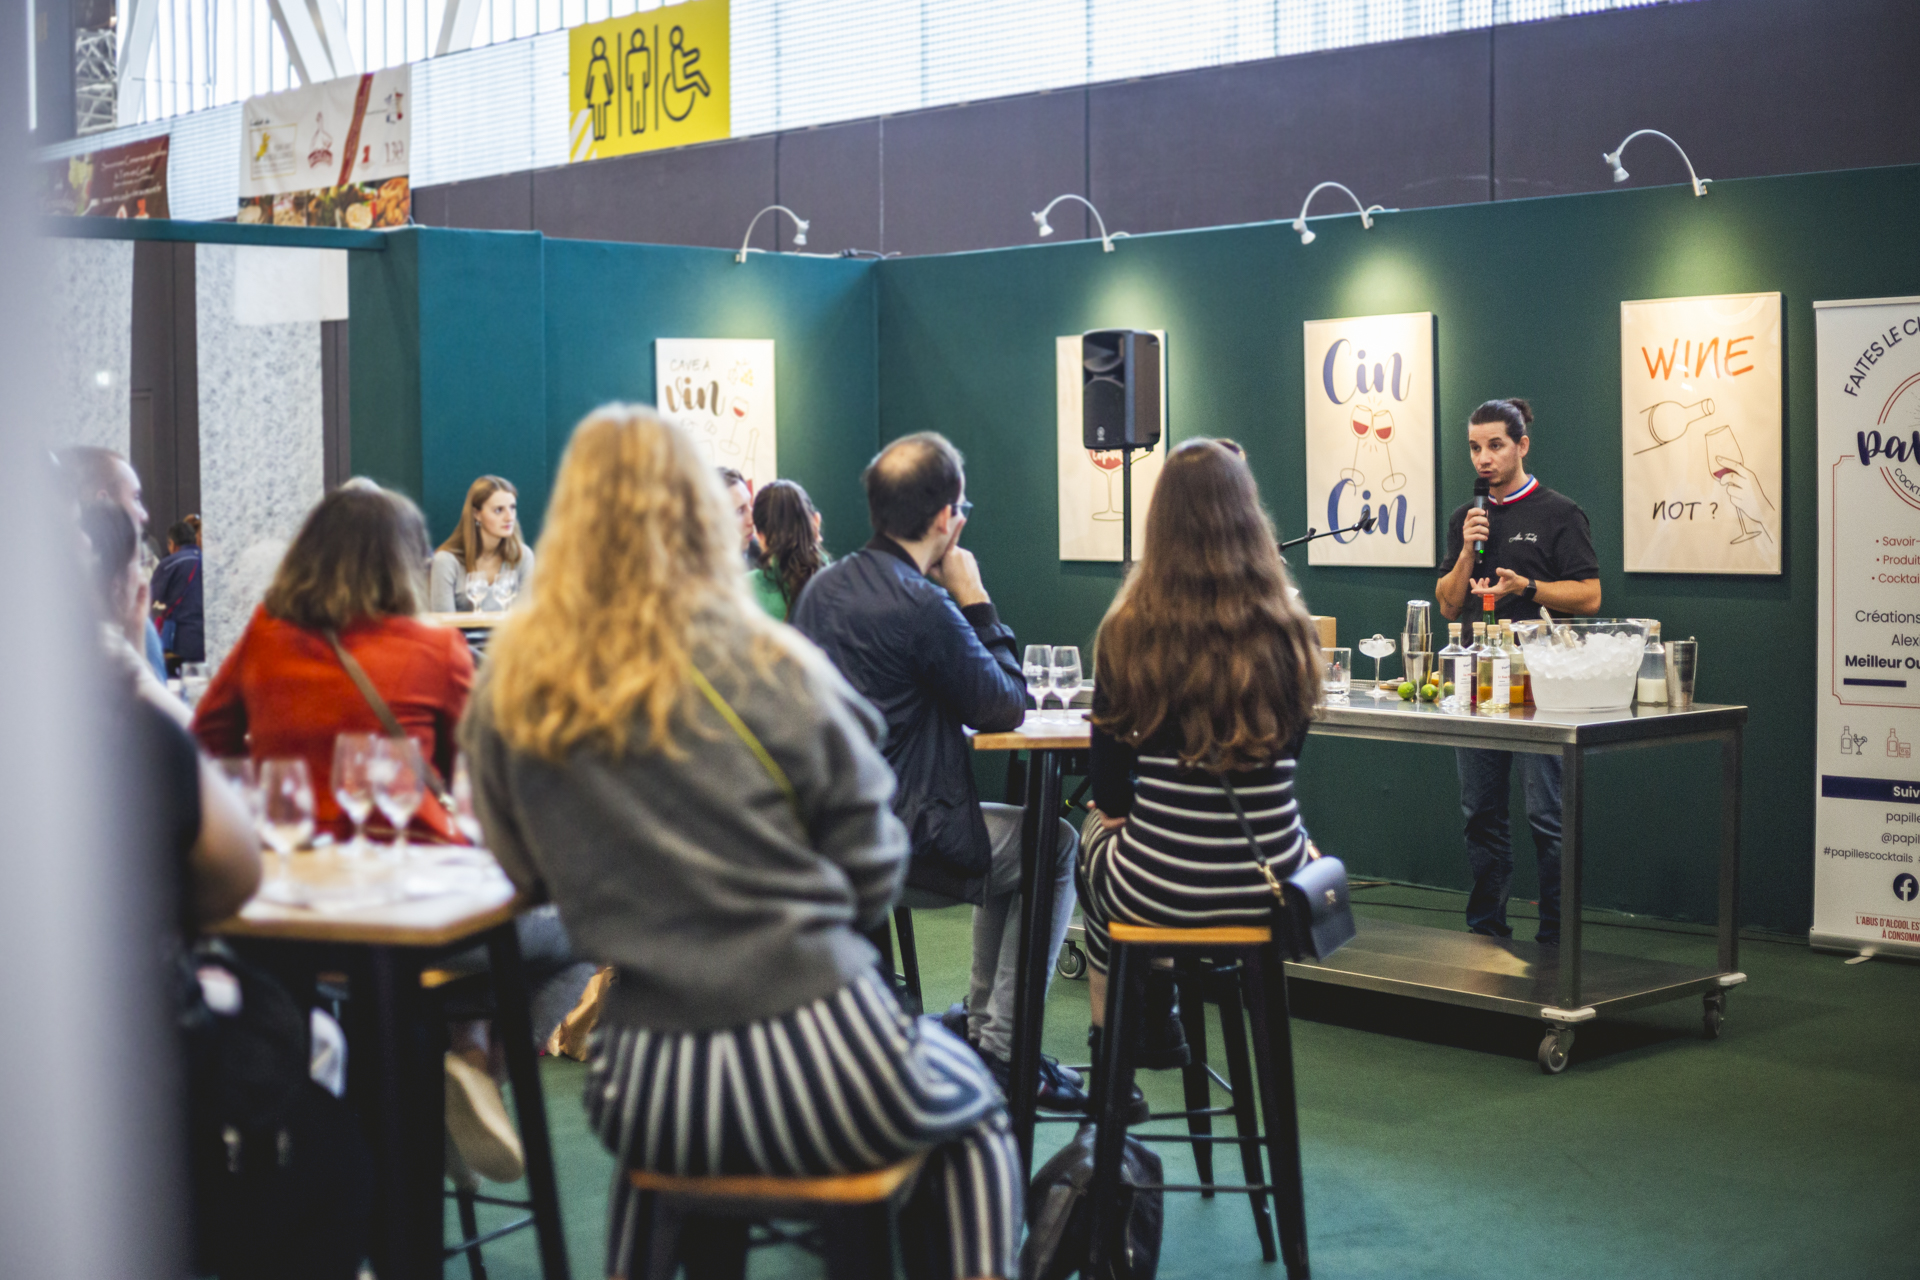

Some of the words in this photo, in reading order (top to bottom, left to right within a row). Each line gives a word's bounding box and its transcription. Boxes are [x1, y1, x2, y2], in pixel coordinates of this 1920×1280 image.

[1323, 338, 1411, 405] Cin
[1844, 341, 1885, 397] FAITES
[1882, 326, 1902, 348] LE
[1894, 467, 1920, 497] COCKT
[1328, 478, 1416, 544] Cin
[1652, 500, 1702, 521] NOT
[1709, 502, 1718, 520] ?
[1855, 609, 1920, 624] Créations
[1845, 654, 1902, 668] Meilleur
[1823, 846, 1914, 864] #papillescocktails
[1856, 915, 1879, 926] L'ABUS
[1880, 918, 1910, 930] D'ALCOOL
[1911, 921, 1920, 931] ES
